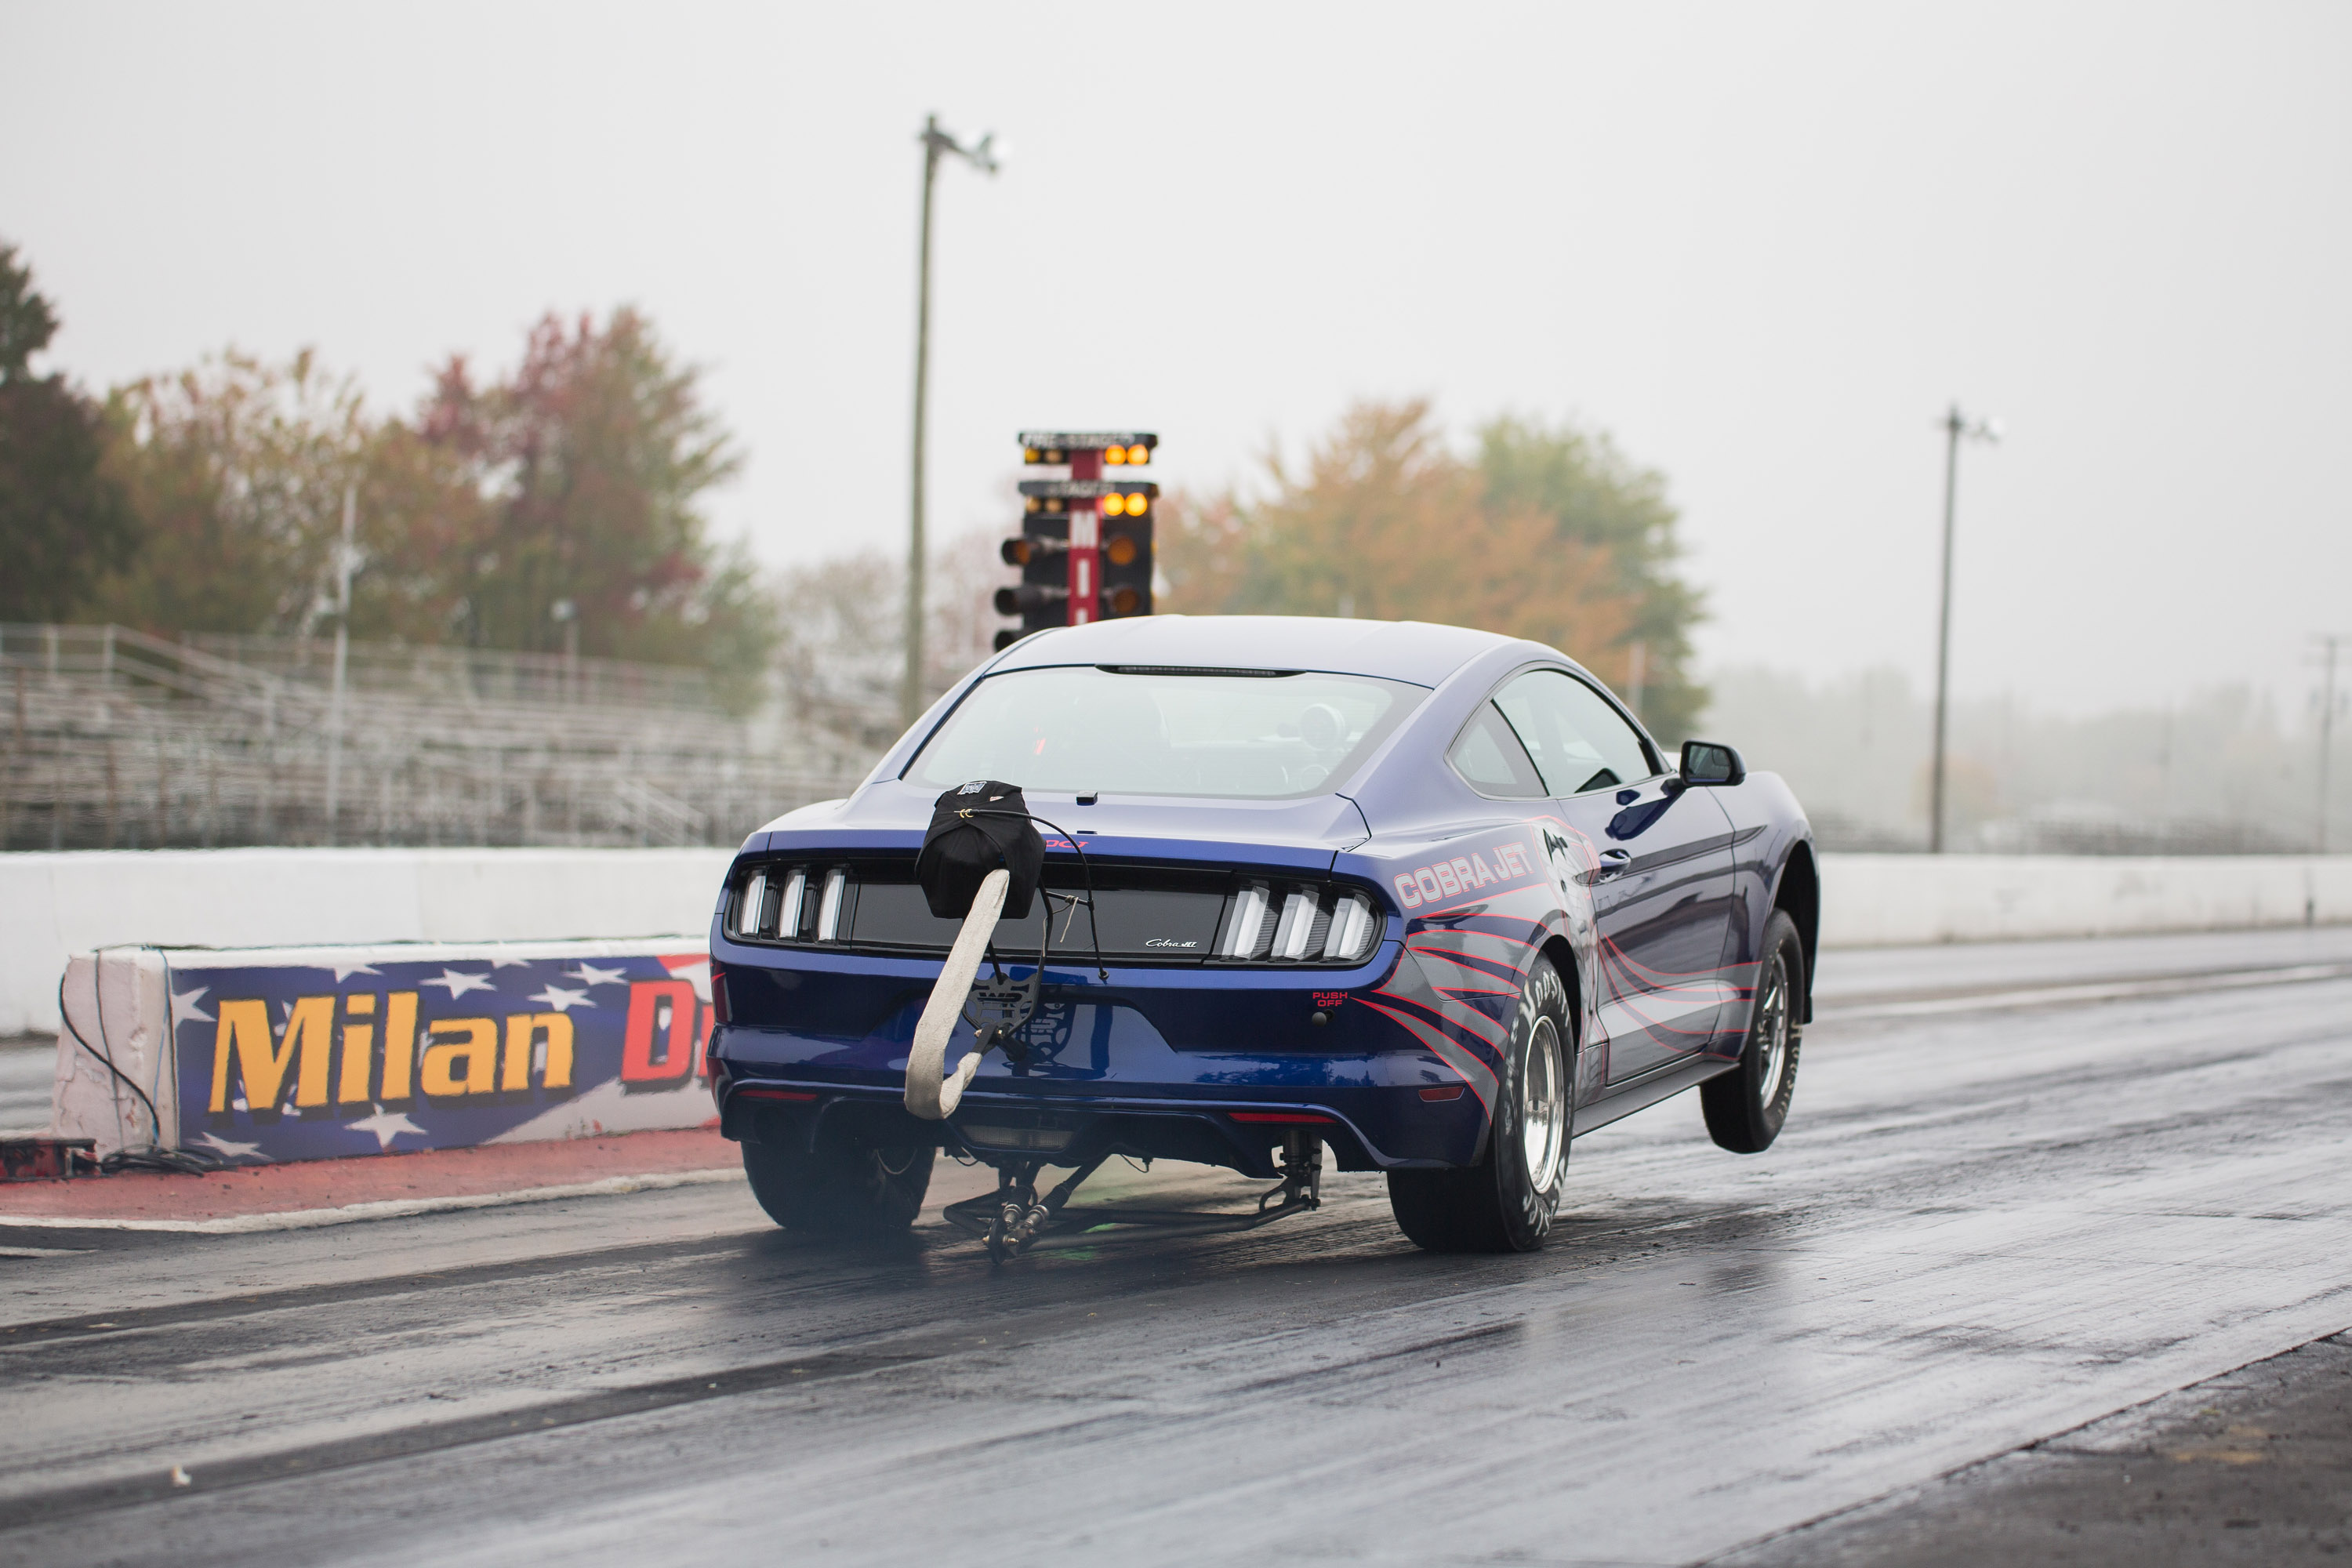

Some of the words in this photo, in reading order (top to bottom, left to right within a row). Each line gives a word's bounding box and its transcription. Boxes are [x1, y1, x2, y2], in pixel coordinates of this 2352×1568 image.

[1394, 852, 1499, 909] COBRA
[1493, 841, 1534, 881] JET
[1145, 938, 1178, 947] Cobra
[208, 990, 575, 1113] Milan
